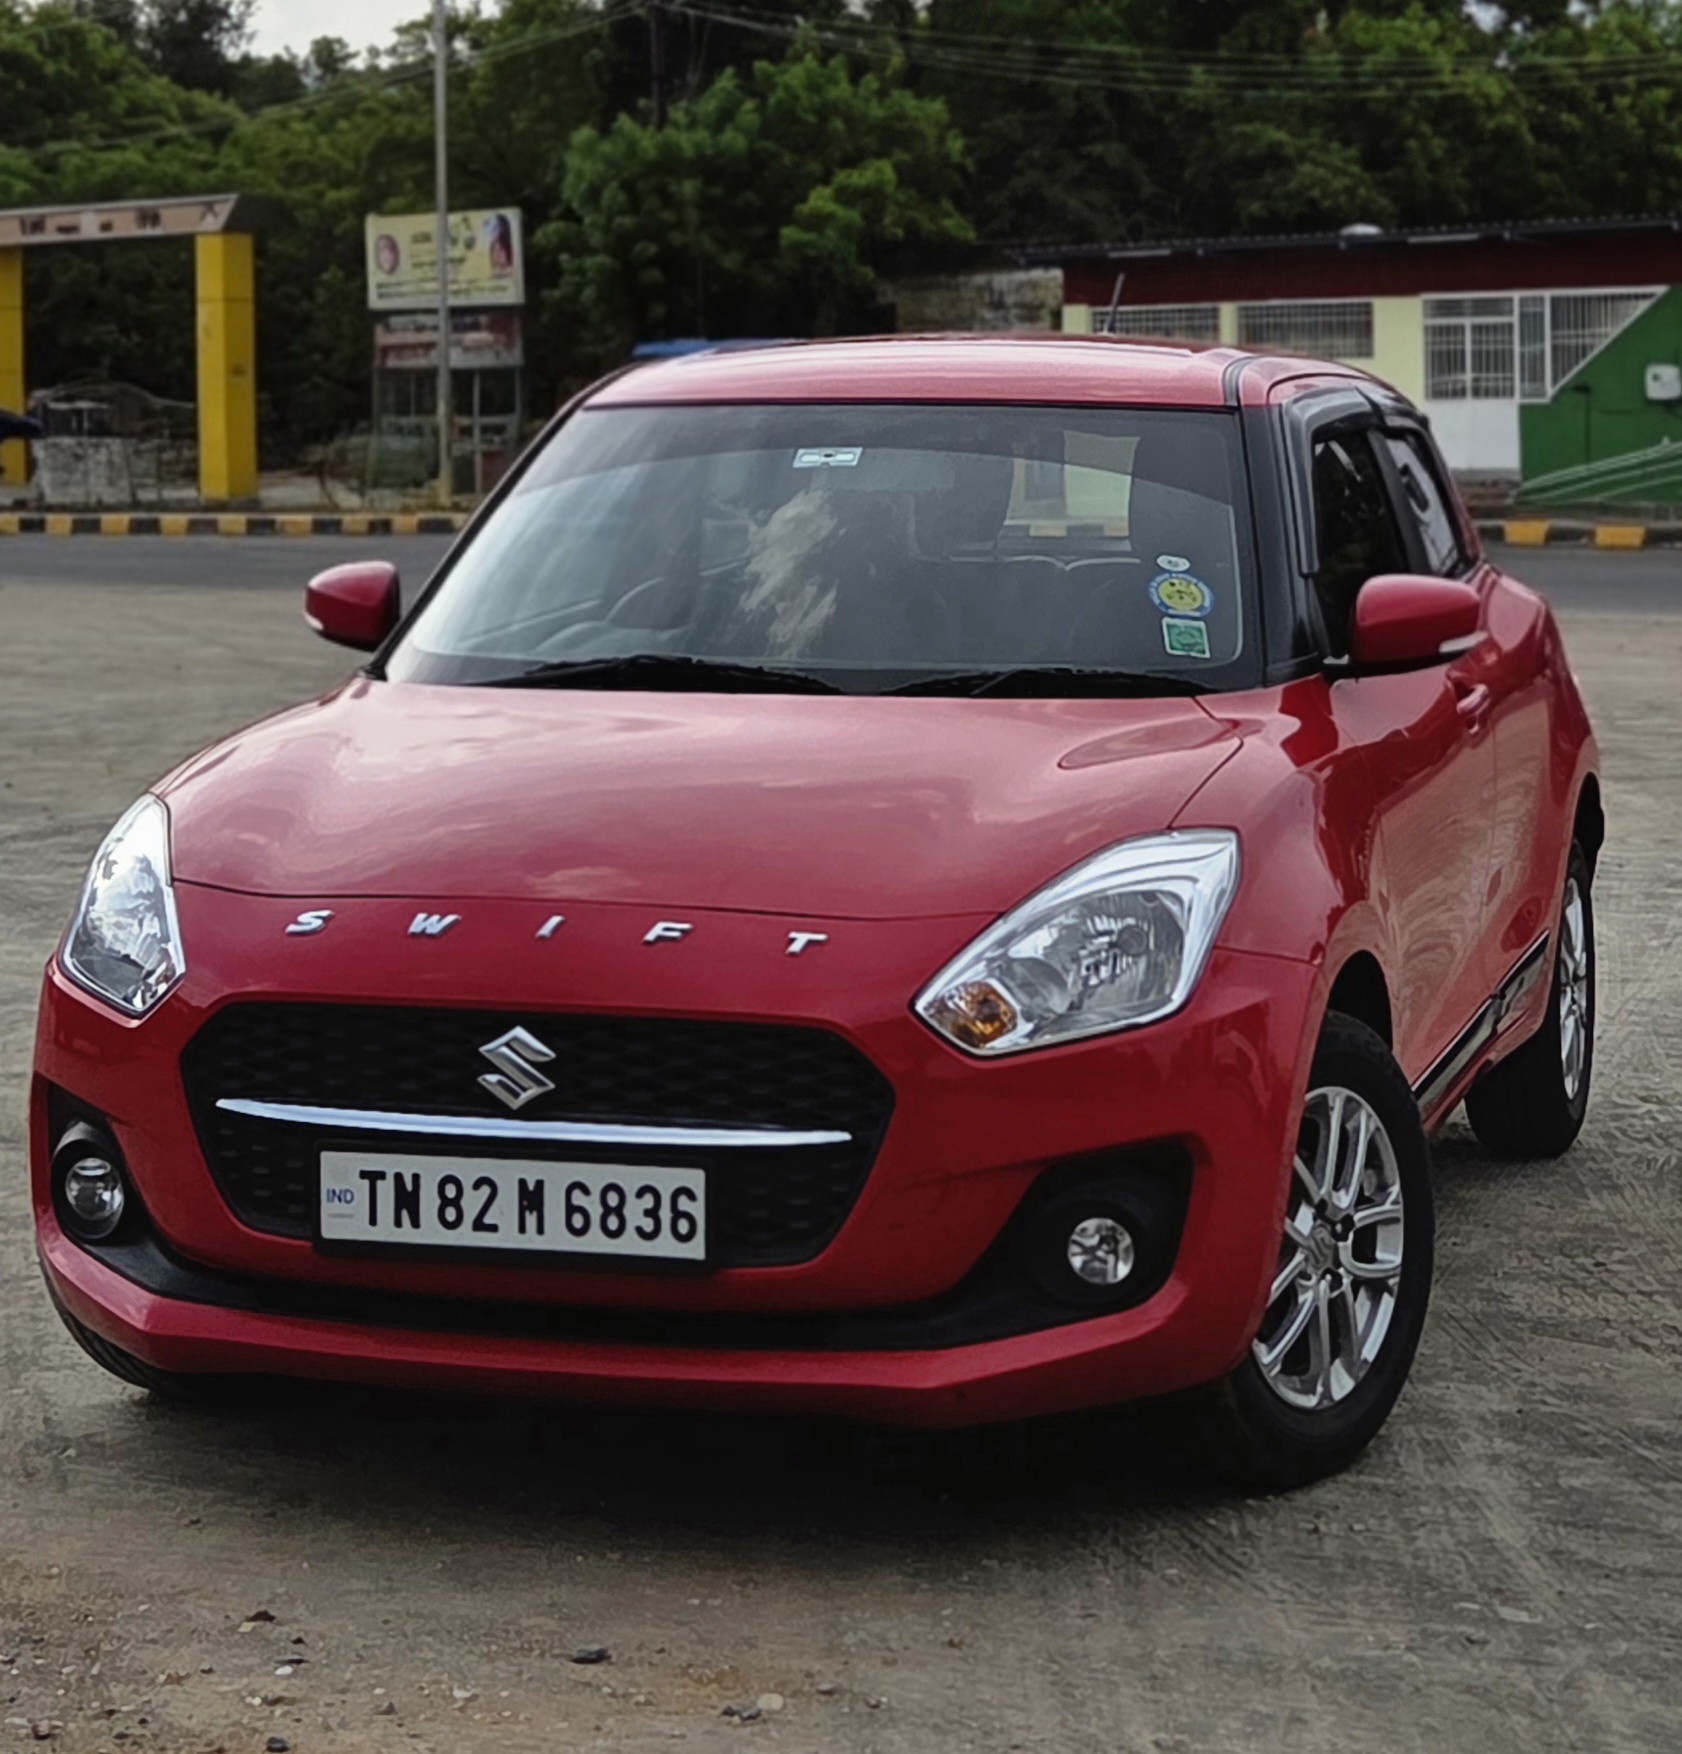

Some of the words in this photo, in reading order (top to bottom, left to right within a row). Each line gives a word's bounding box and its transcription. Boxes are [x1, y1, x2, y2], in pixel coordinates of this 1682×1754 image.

[285, 909, 828, 956] SWIFT
[326, 1188, 355, 1205] IND
[359, 1169, 421, 1229] TN
[436, 1174, 499, 1233] 82
[517, 1177, 545, 1236] M
[564, 1180, 698, 1243] 6836
